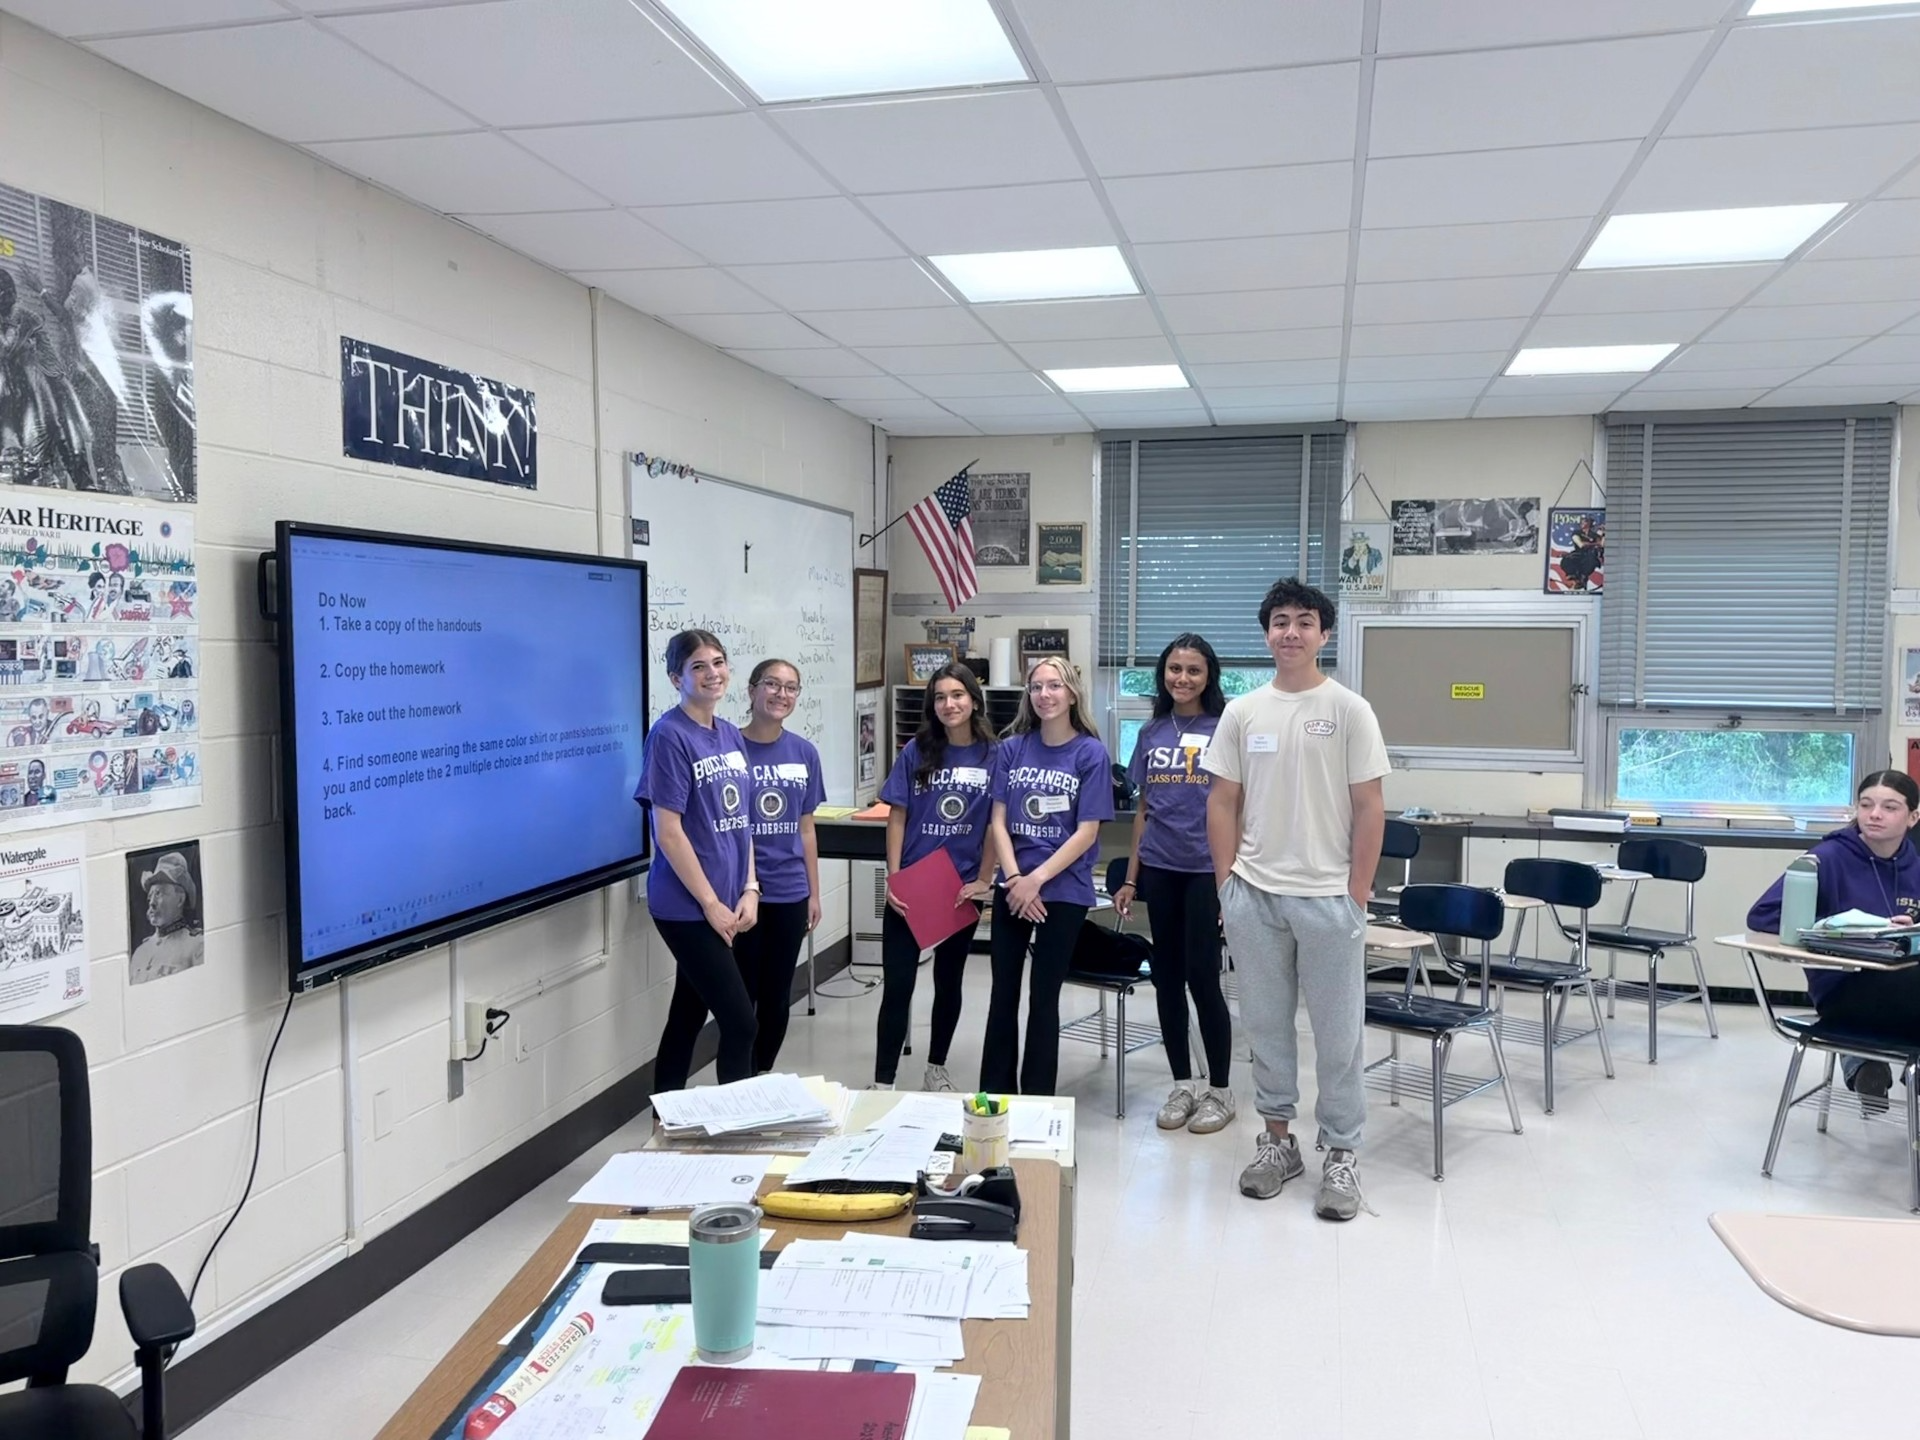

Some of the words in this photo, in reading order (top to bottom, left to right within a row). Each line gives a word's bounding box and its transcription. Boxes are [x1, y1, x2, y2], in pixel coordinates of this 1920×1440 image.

[351, 354, 529, 478] THINK!
[0, 507, 33, 527] AR
[37, 507, 143, 537] HERITAGE
[11, 528, 38, 537] WORLD
[40, 531, 55, 539] WAR
[1339, 575, 1363, 584] WANT
[1366, 575, 1384, 584] YOU
[318, 592, 336, 607] Do
[340, 593, 367, 608] Now
[319, 616, 330, 631] 1.
[334, 616, 361, 631] Take
[365, 619, 371, 631] a
[375, 619, 401, 634] copy
[405, 618, 416, 631] of
[418, 618, 434, 631] the
[437, 618, 482, 632] handouts
[320, 664, 331, 679] 2.
[335, 663, 366, 680] Copy
[369, 662, 387, 676] the
[390, 661, 445, 675] homework
[322, 711, 332, 726] 3.
[336, 710, 364, 725] Take
[367, 707, 386, 722] out
[388, 706, 406, 720] the
[409, 701, 462, 718] homework
[323, 758, 333, 773] 4.
[338, 754, 364, 771] Find
[367, 750, 418, 767] someone
[420, 743, 460, 759] wearing
[462, 741, 477, 754] the
[480, 739, 503, 752] same
[506, 735, 527, 748] color
[529, 733, 548, 745] shirt
[550, 732, 558, 742] or
[322, 782, 346, 800] you
[350, 776, 371, 793] and
[374, 770, 425, 788] complete
[427, 766, 443, 780] the
[445, 764, 451, 777] 2
[454, 757, 492, 777] multiple
[494, 755, 522, 770] choice
[524, 752, 540, 765] and
[541, 750, 554, 762] the
[555, 745, 585, 763] practice
[586, 744, 601, 757] quiz
[603, 742, 612, 752] on
[612, 740, 624, 751] the
[1147, 774, 1170, 784] CLASS
[1171, 774, 1183, 784] OF
[324, 802, 356, 820] back.
[751, 822, 798, 835] EADERSHIP
[1, 847, 47, 865] Watergate
